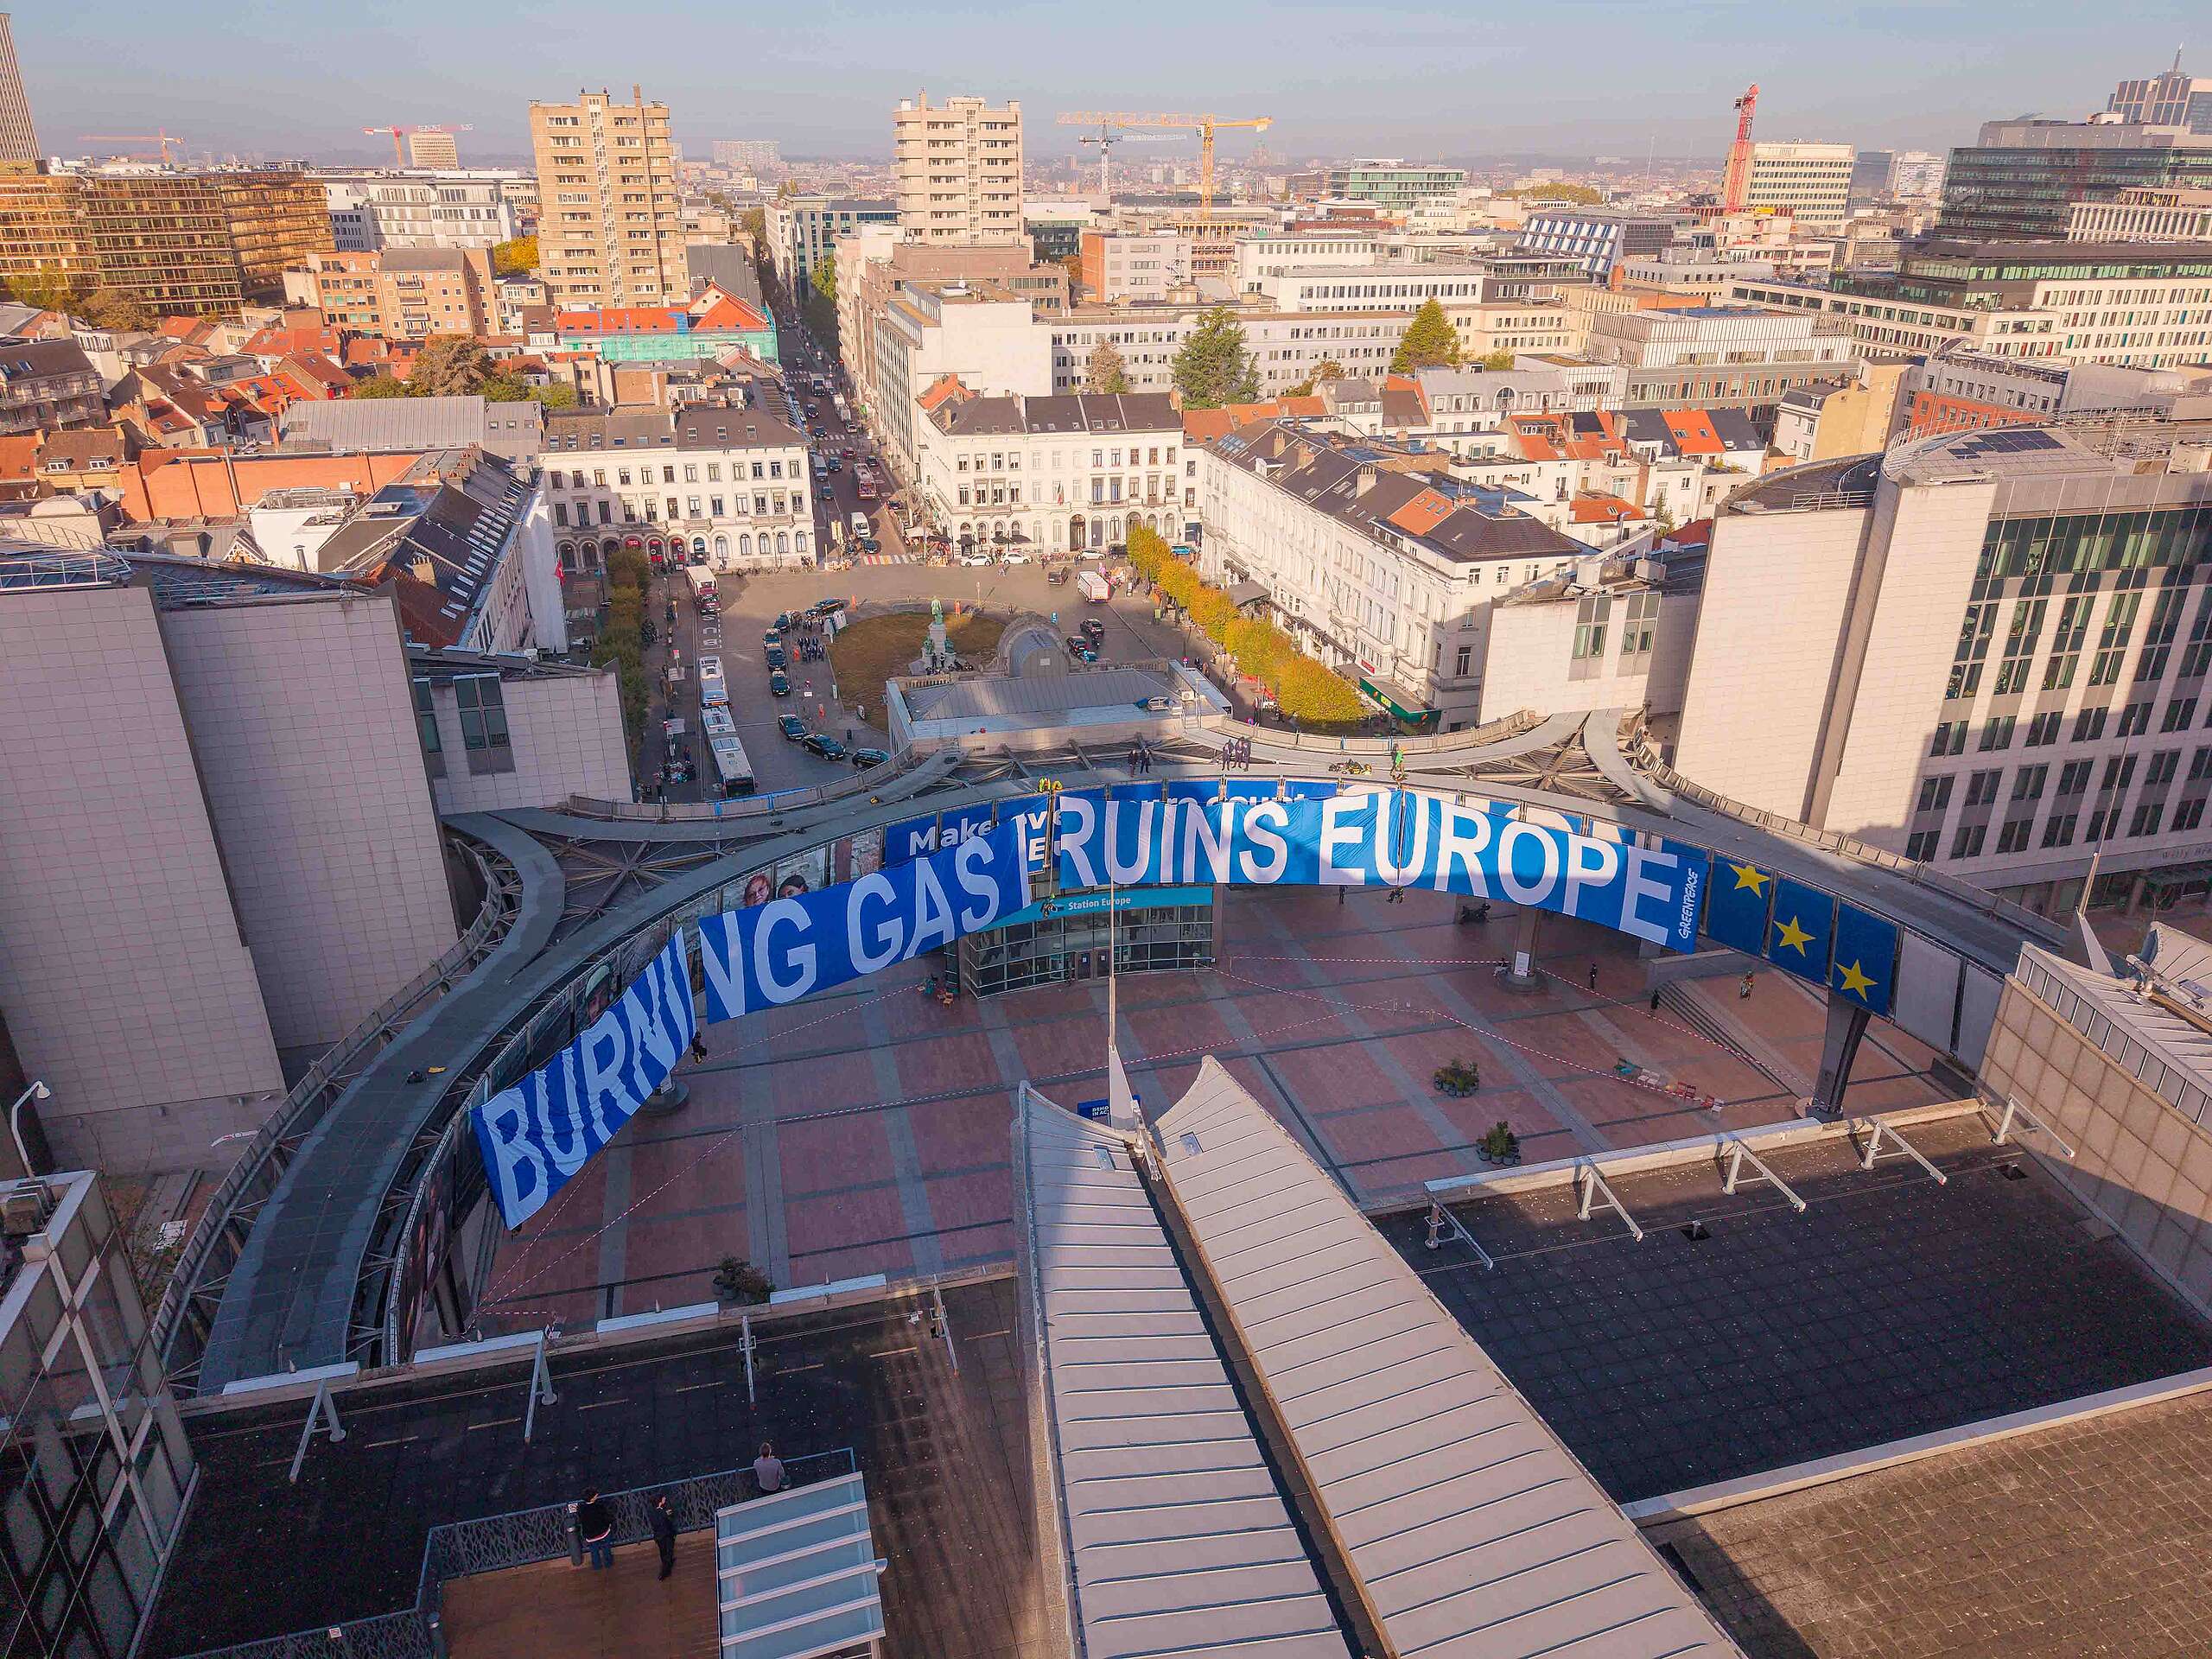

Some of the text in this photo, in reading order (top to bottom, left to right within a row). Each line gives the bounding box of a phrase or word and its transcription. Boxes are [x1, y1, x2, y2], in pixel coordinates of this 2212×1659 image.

[909, 817, 1000, 856] Make
[1068, 897, 1131, 911] Station Euope
[1678, 867, 1699, 939] GREENPEACE
[480, 900, 817, 1230] BURNING
[845, 835, 1000, 975] GAS
[1014, 795, 1290, 909] RUINS
[1318, 790, 1679, 946] EUROPE
